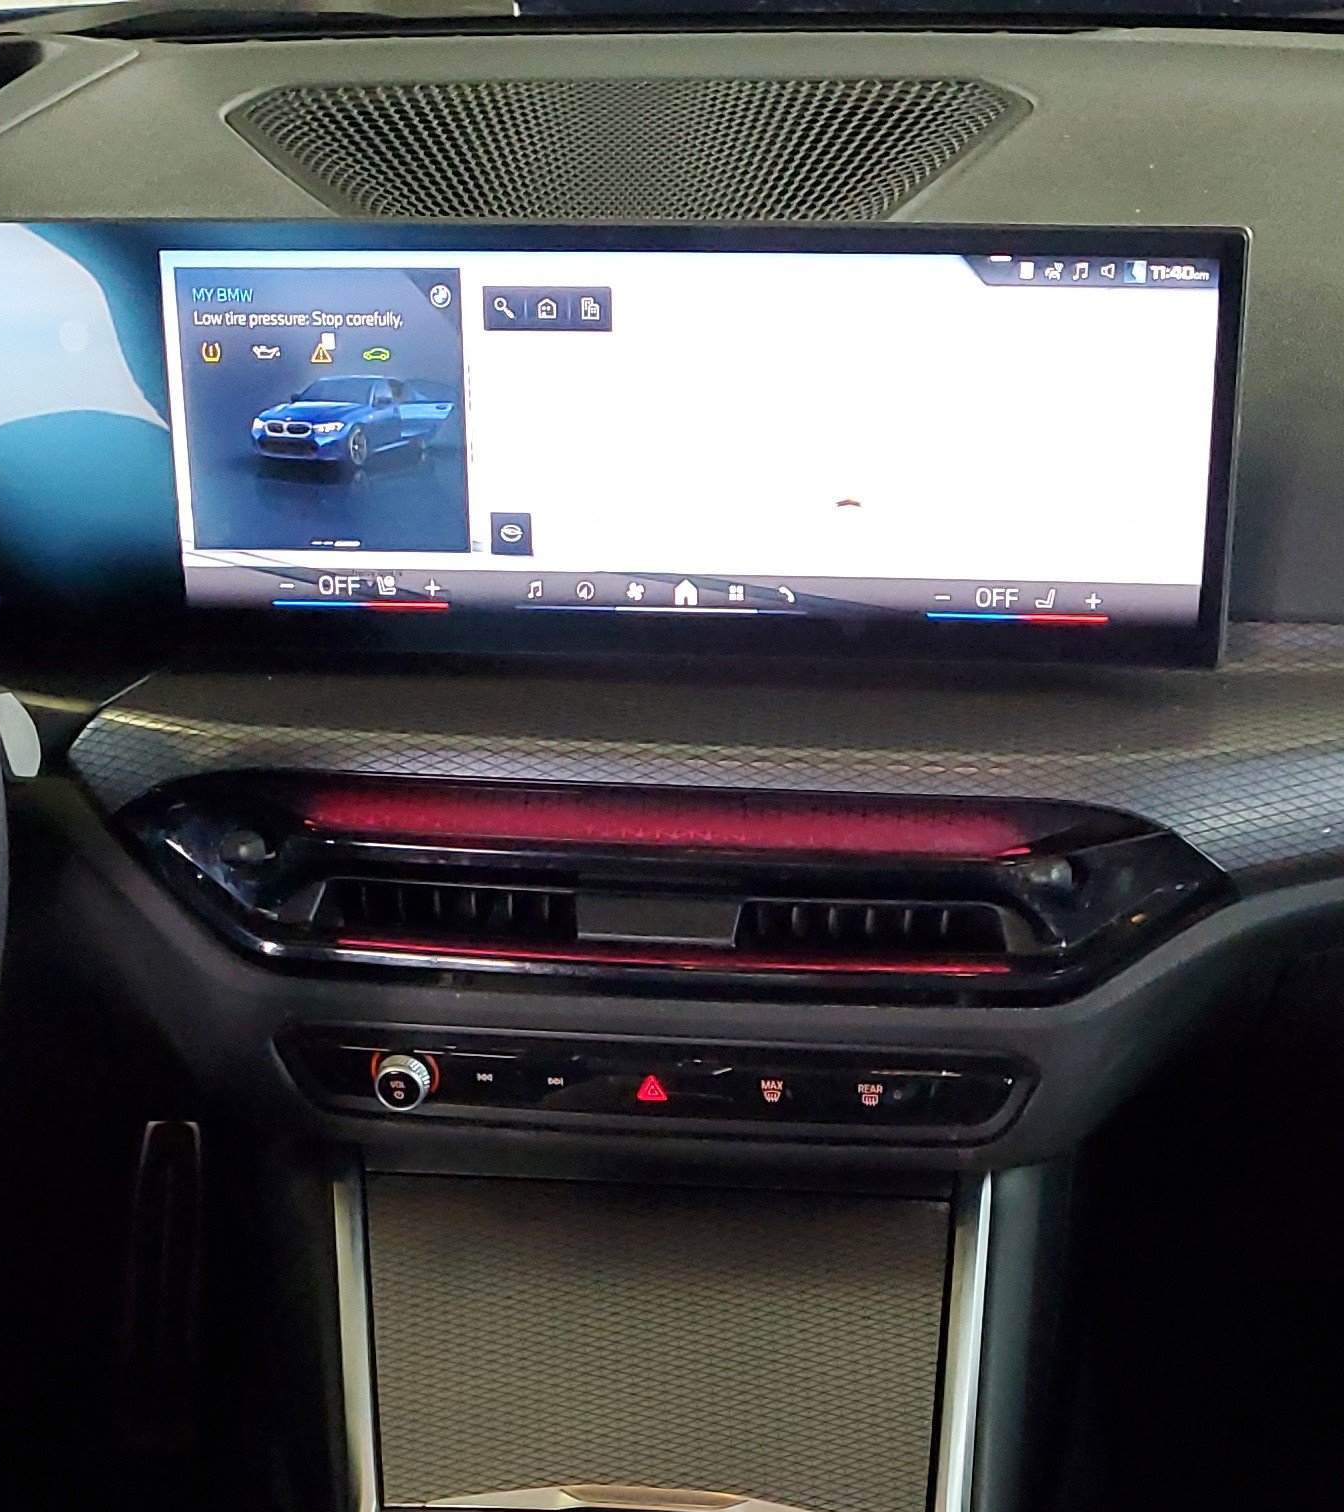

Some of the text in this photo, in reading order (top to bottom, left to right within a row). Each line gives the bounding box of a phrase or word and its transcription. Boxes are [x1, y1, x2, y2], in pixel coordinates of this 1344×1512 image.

[192, 288, 253, 302] MY BMW
[194, 311, 225, 326] Low
[225, 311, 247, 326] tire
[249, 313, 310, 328] pressure:
[312, 312, 343, 329] Stop
[318, 575, 361, 596] OFF
[975, 587, 1020, 609] OFF
[761, 1079, 784, 1091] MAX
[858, 1083, 884, 1094] REAR
